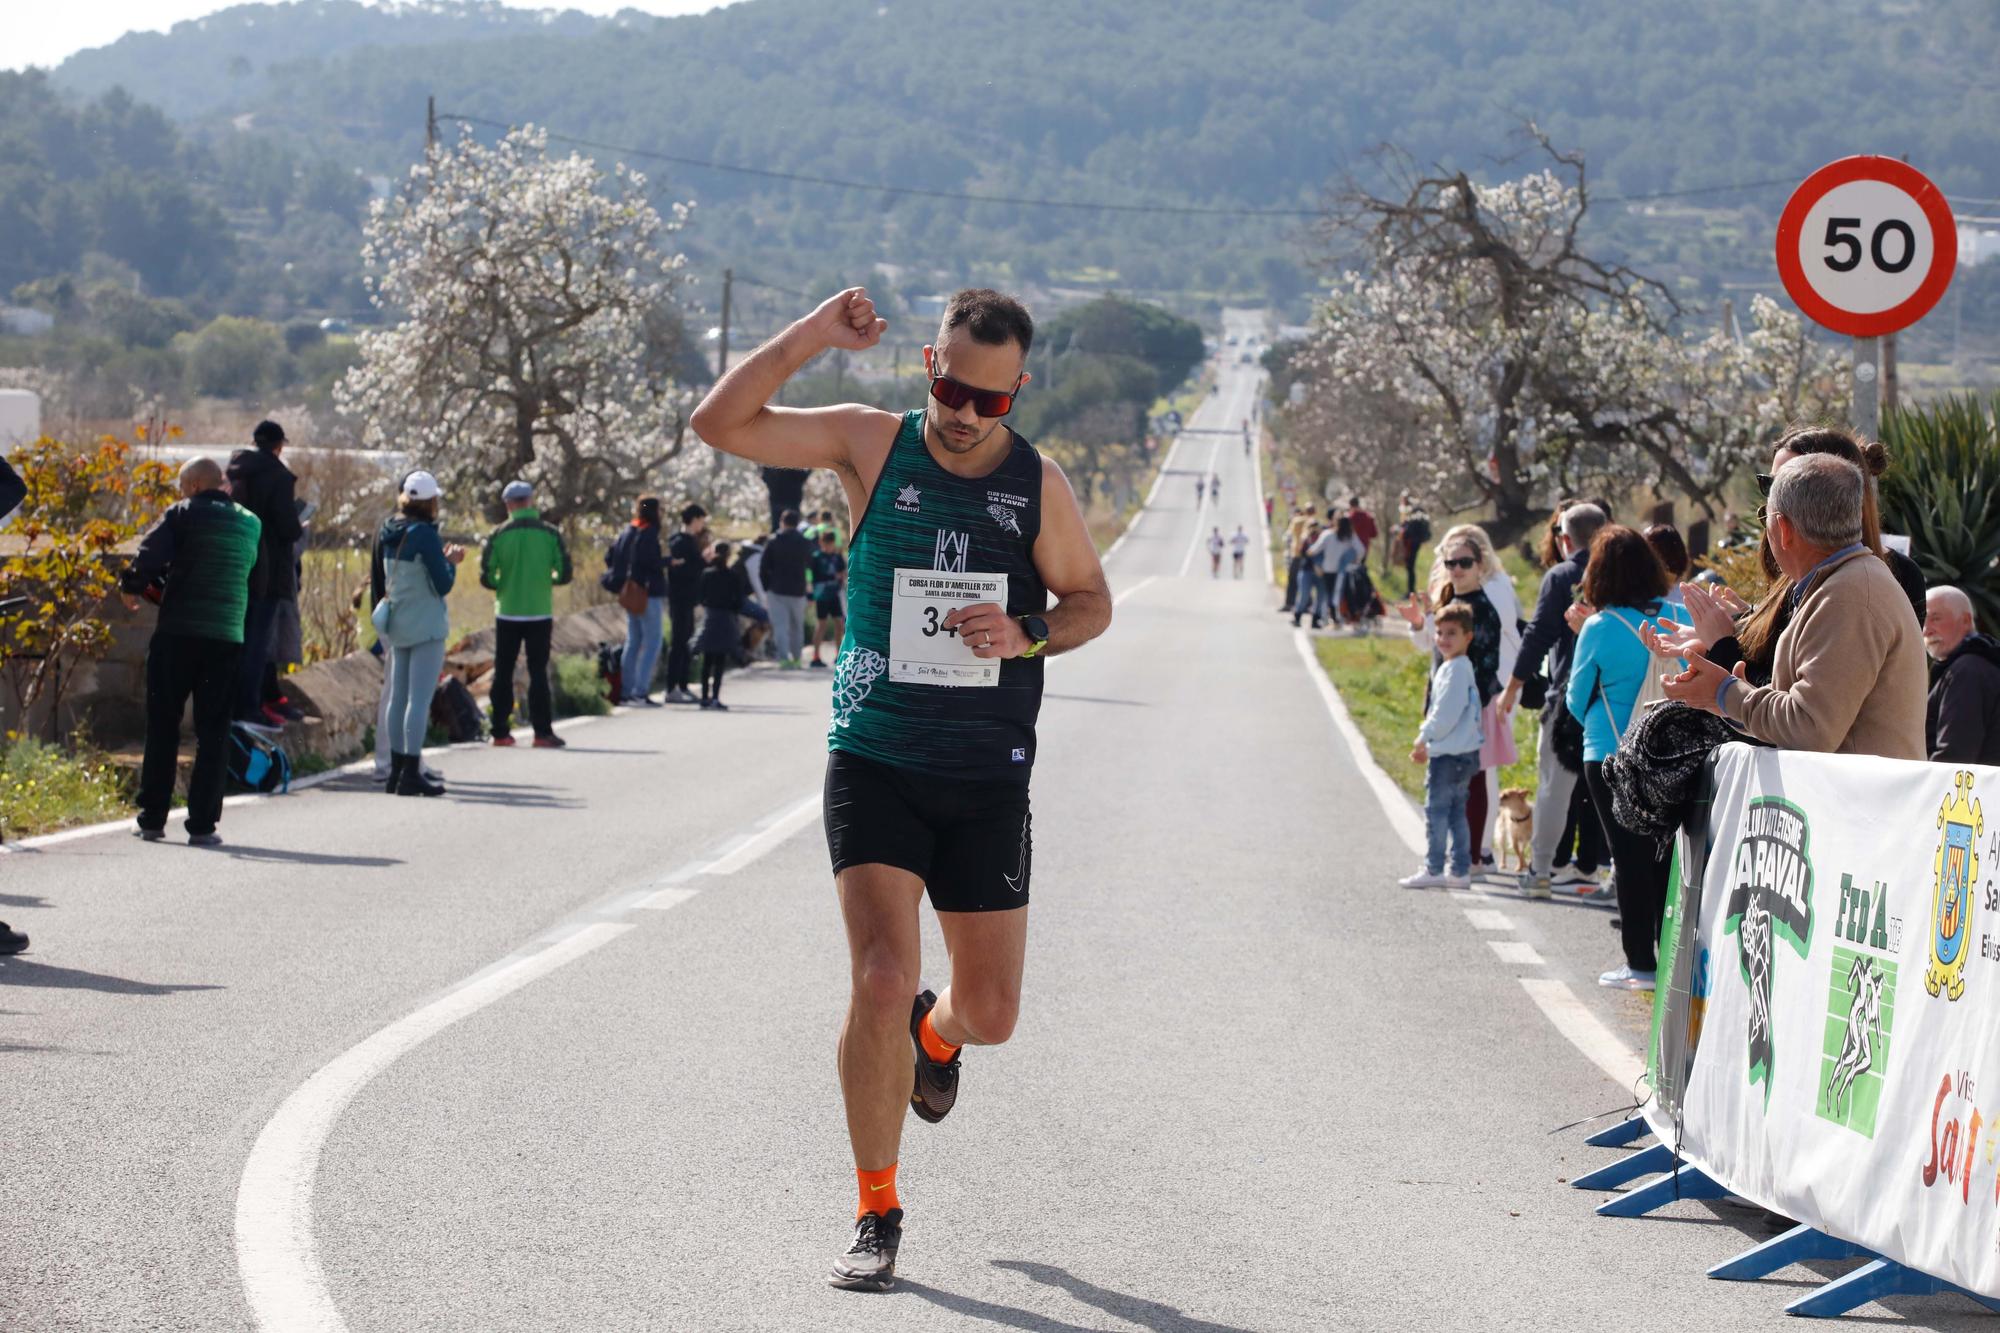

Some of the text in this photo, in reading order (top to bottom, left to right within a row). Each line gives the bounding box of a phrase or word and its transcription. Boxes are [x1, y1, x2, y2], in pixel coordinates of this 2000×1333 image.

[1823, 217, 1916, 274] 50
[894, 502, 920, 513] luanvi
[909, 579, 997, 592] CORSA FLOR D'AMETLLER 2023
[1753, 840, 1807, 918] RAVAL
